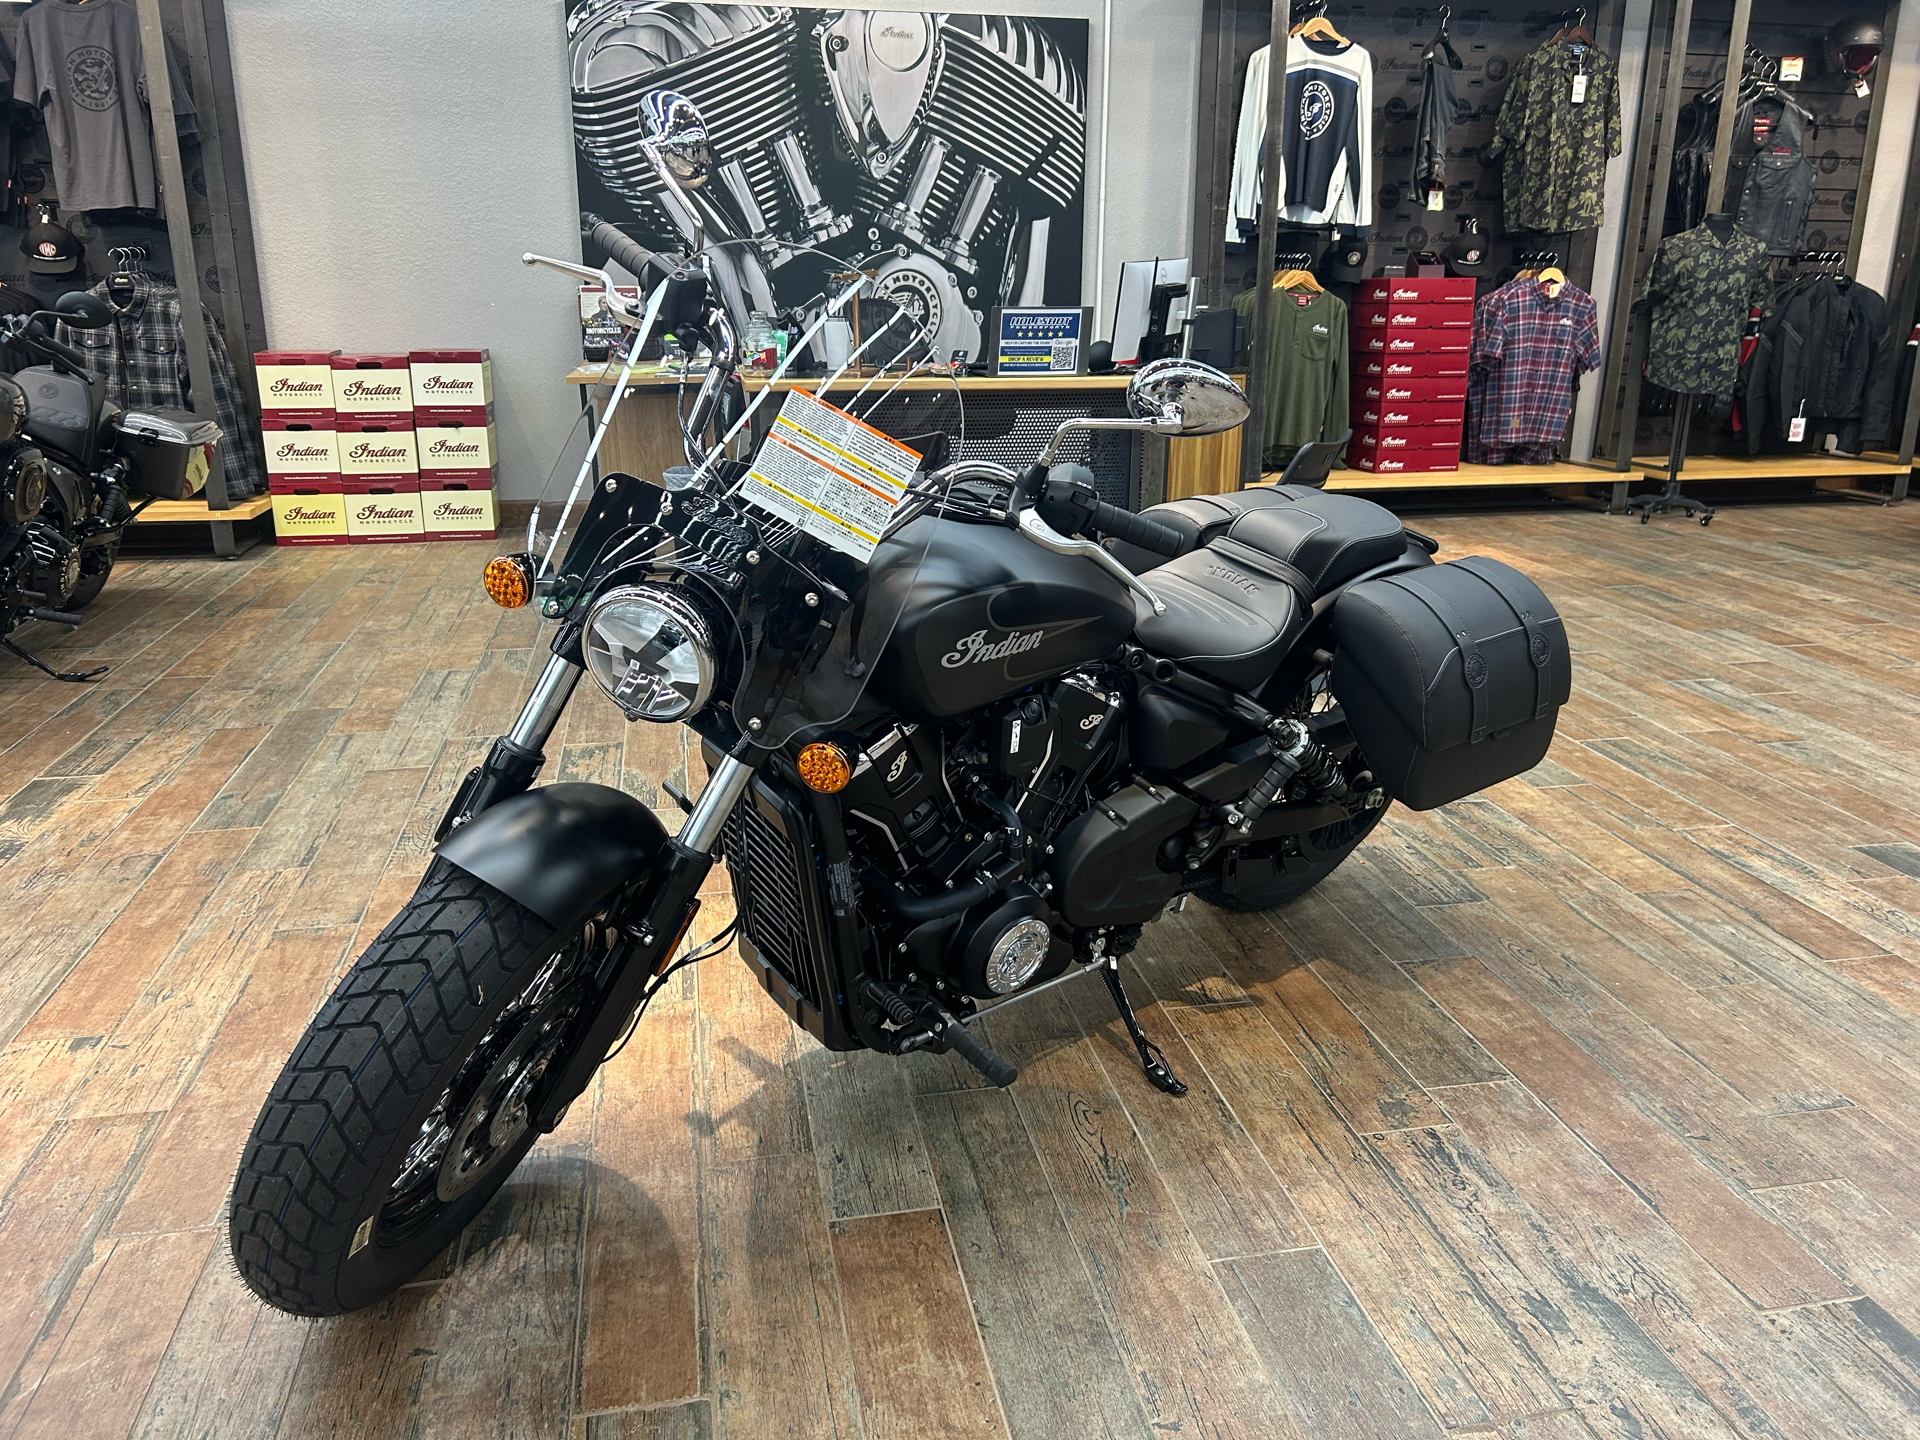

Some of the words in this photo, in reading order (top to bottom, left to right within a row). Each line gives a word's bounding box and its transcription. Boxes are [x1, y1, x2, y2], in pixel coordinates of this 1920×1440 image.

[881, 26, 914, 39] Indian
[1393, 289, 1418, 297] Indian
[1010, 317, 1073, 325] HOLESHOT
[1392, 314, 1416, 323] Indian
[1390, 339, 1415, 348] Indian
[1387, 363, 1412, 372] Indian
[270, 378, 323, 392] Indian
[343, 381, 402, 396] Indian
[423, 376, 474, 389] Indian
[1386, 389, 1411, 397] Indian
[1384, 413, 1408, 421] Indian
[802, 430, 820, 442] CAUTION
[1382, 437, 1406, 445] Indian
[276, 443, 328, 457] Indian
[349, 443, 407, 458] Indian
[429, 440, 479, 453] Indian
[1380, 460, 1404, 468] Indian
[773, 484, 794, 498] ATTENTION
[284, 507, 336, 520] Indian
[356, 505, 414, 519] Indian
[433, 503, 483, 516] Indian
[1206, 566, 1259, 596] INDIAN
[941, 629, 1044, 668] Indian
